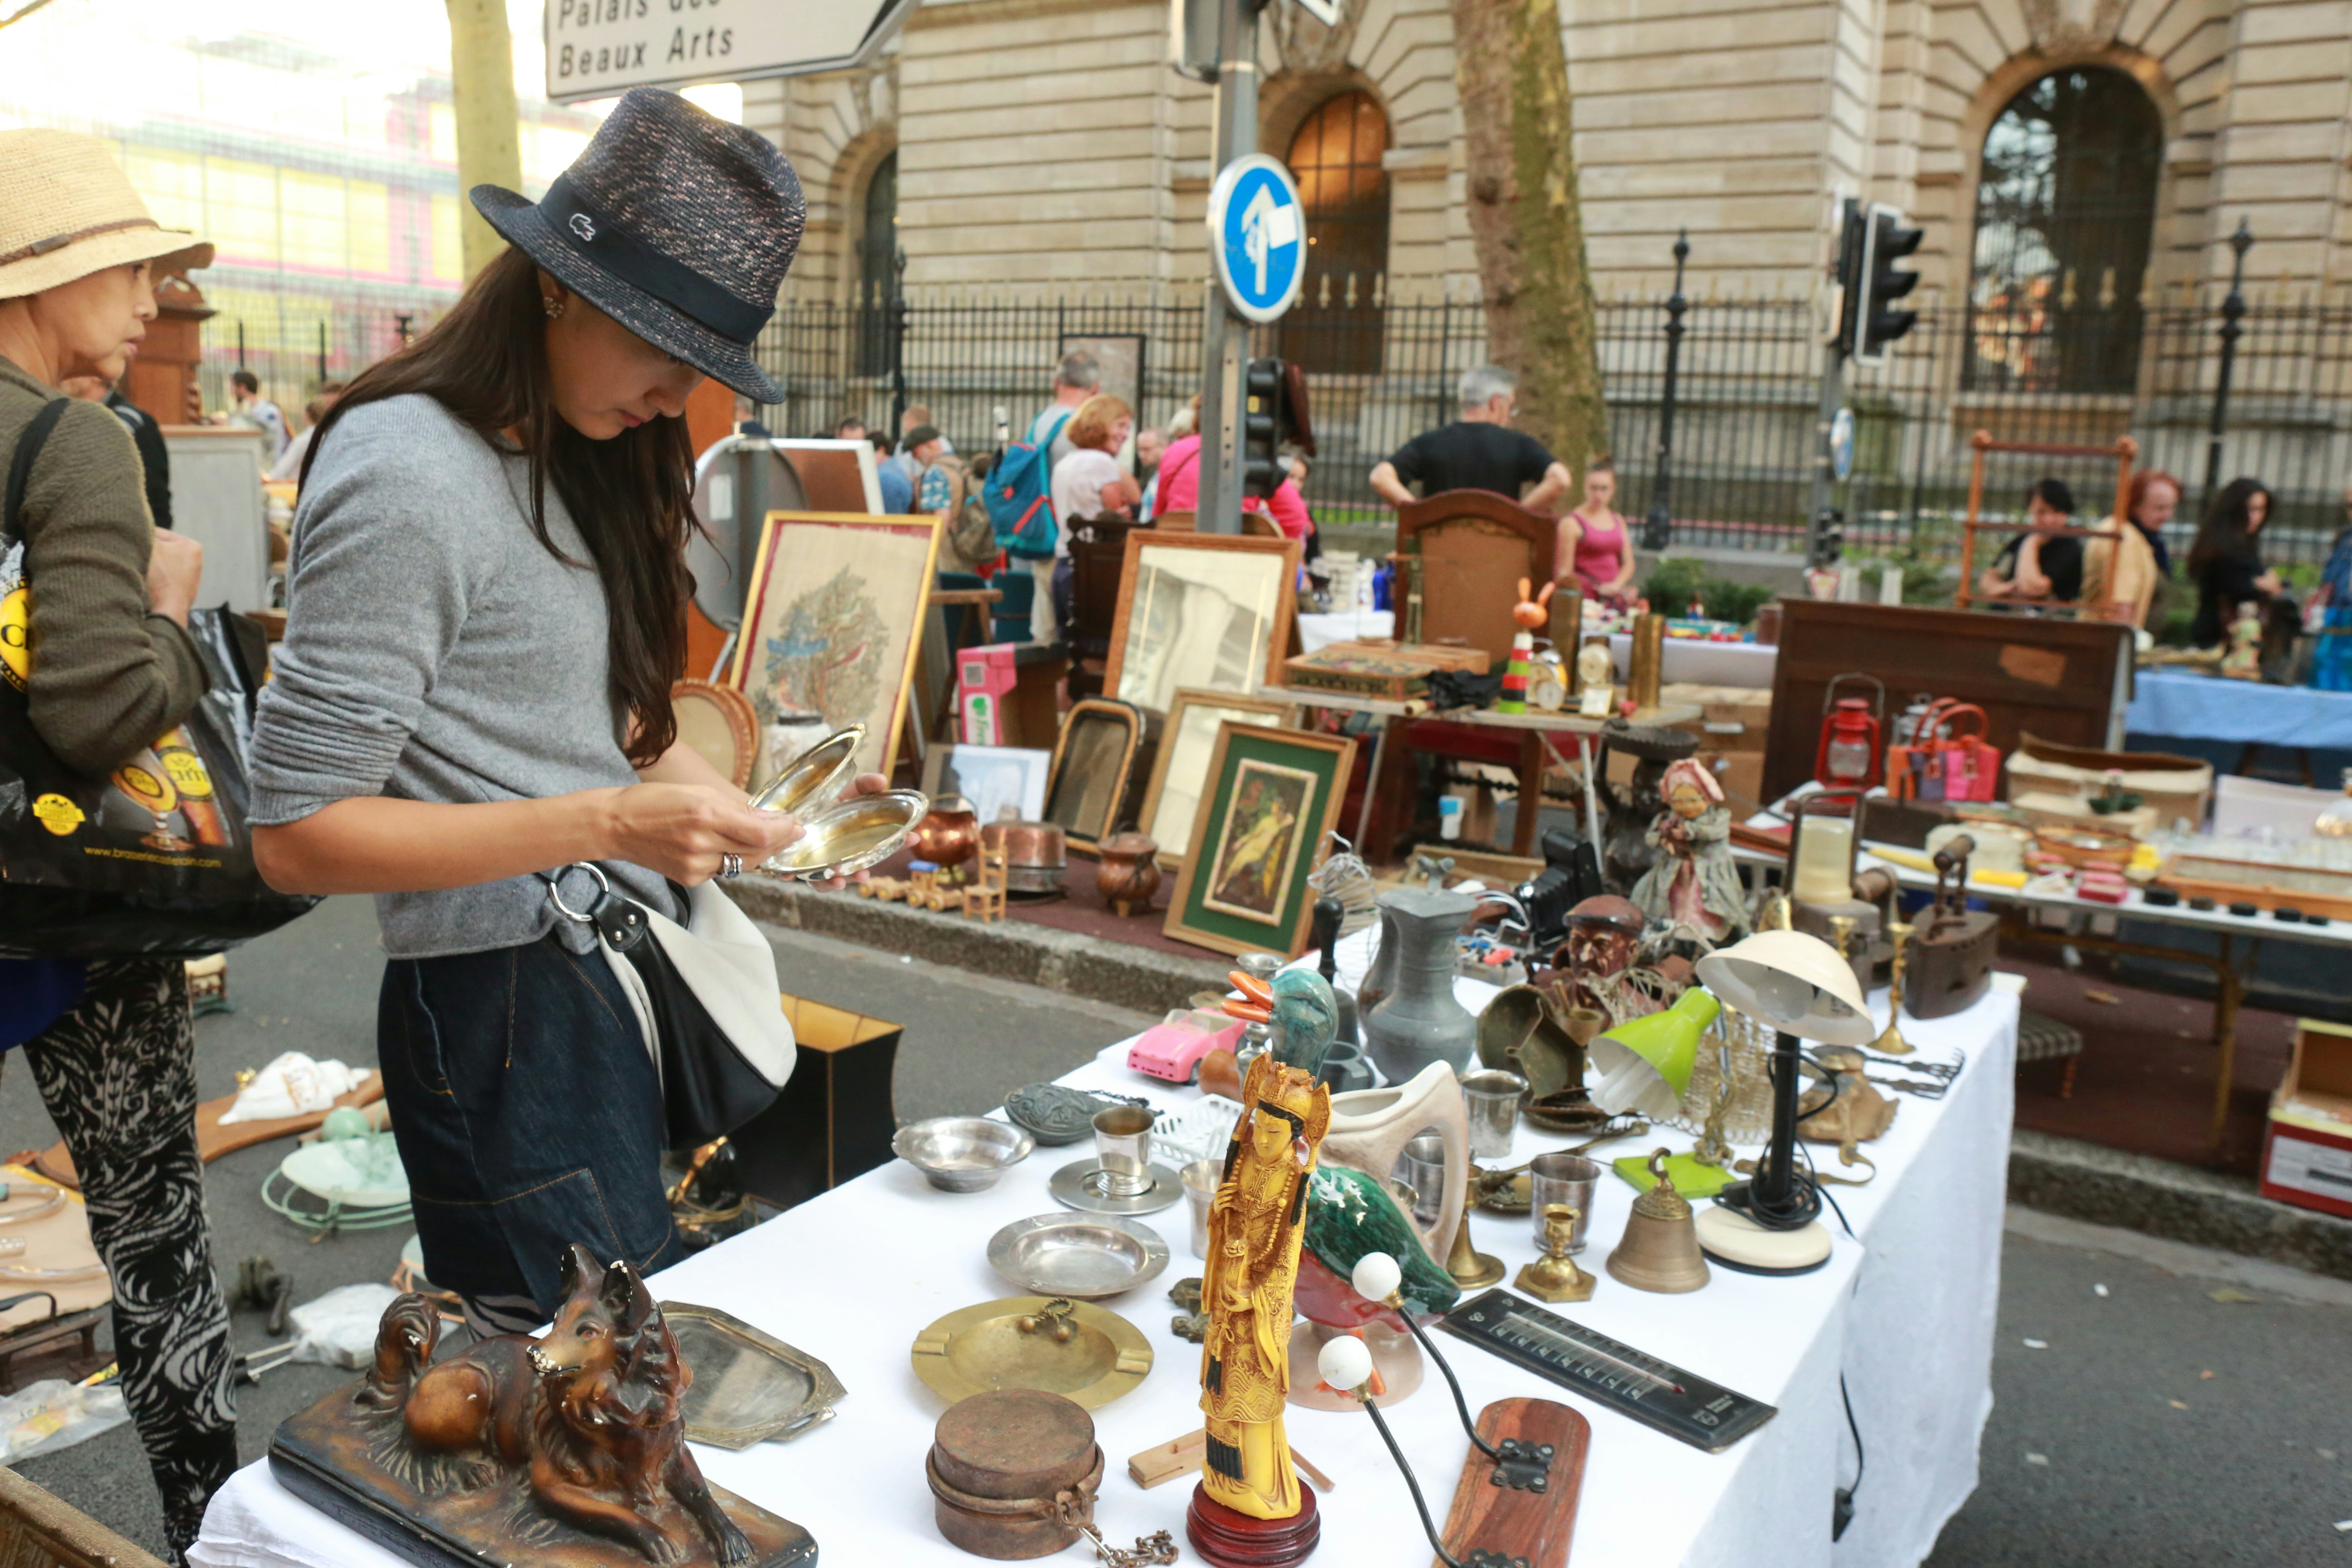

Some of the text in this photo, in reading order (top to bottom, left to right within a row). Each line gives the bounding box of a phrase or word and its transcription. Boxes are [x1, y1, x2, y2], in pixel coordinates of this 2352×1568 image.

[558, 0, 648, 29] Palais
[560, 26, 733, 78] Beaux Arts
